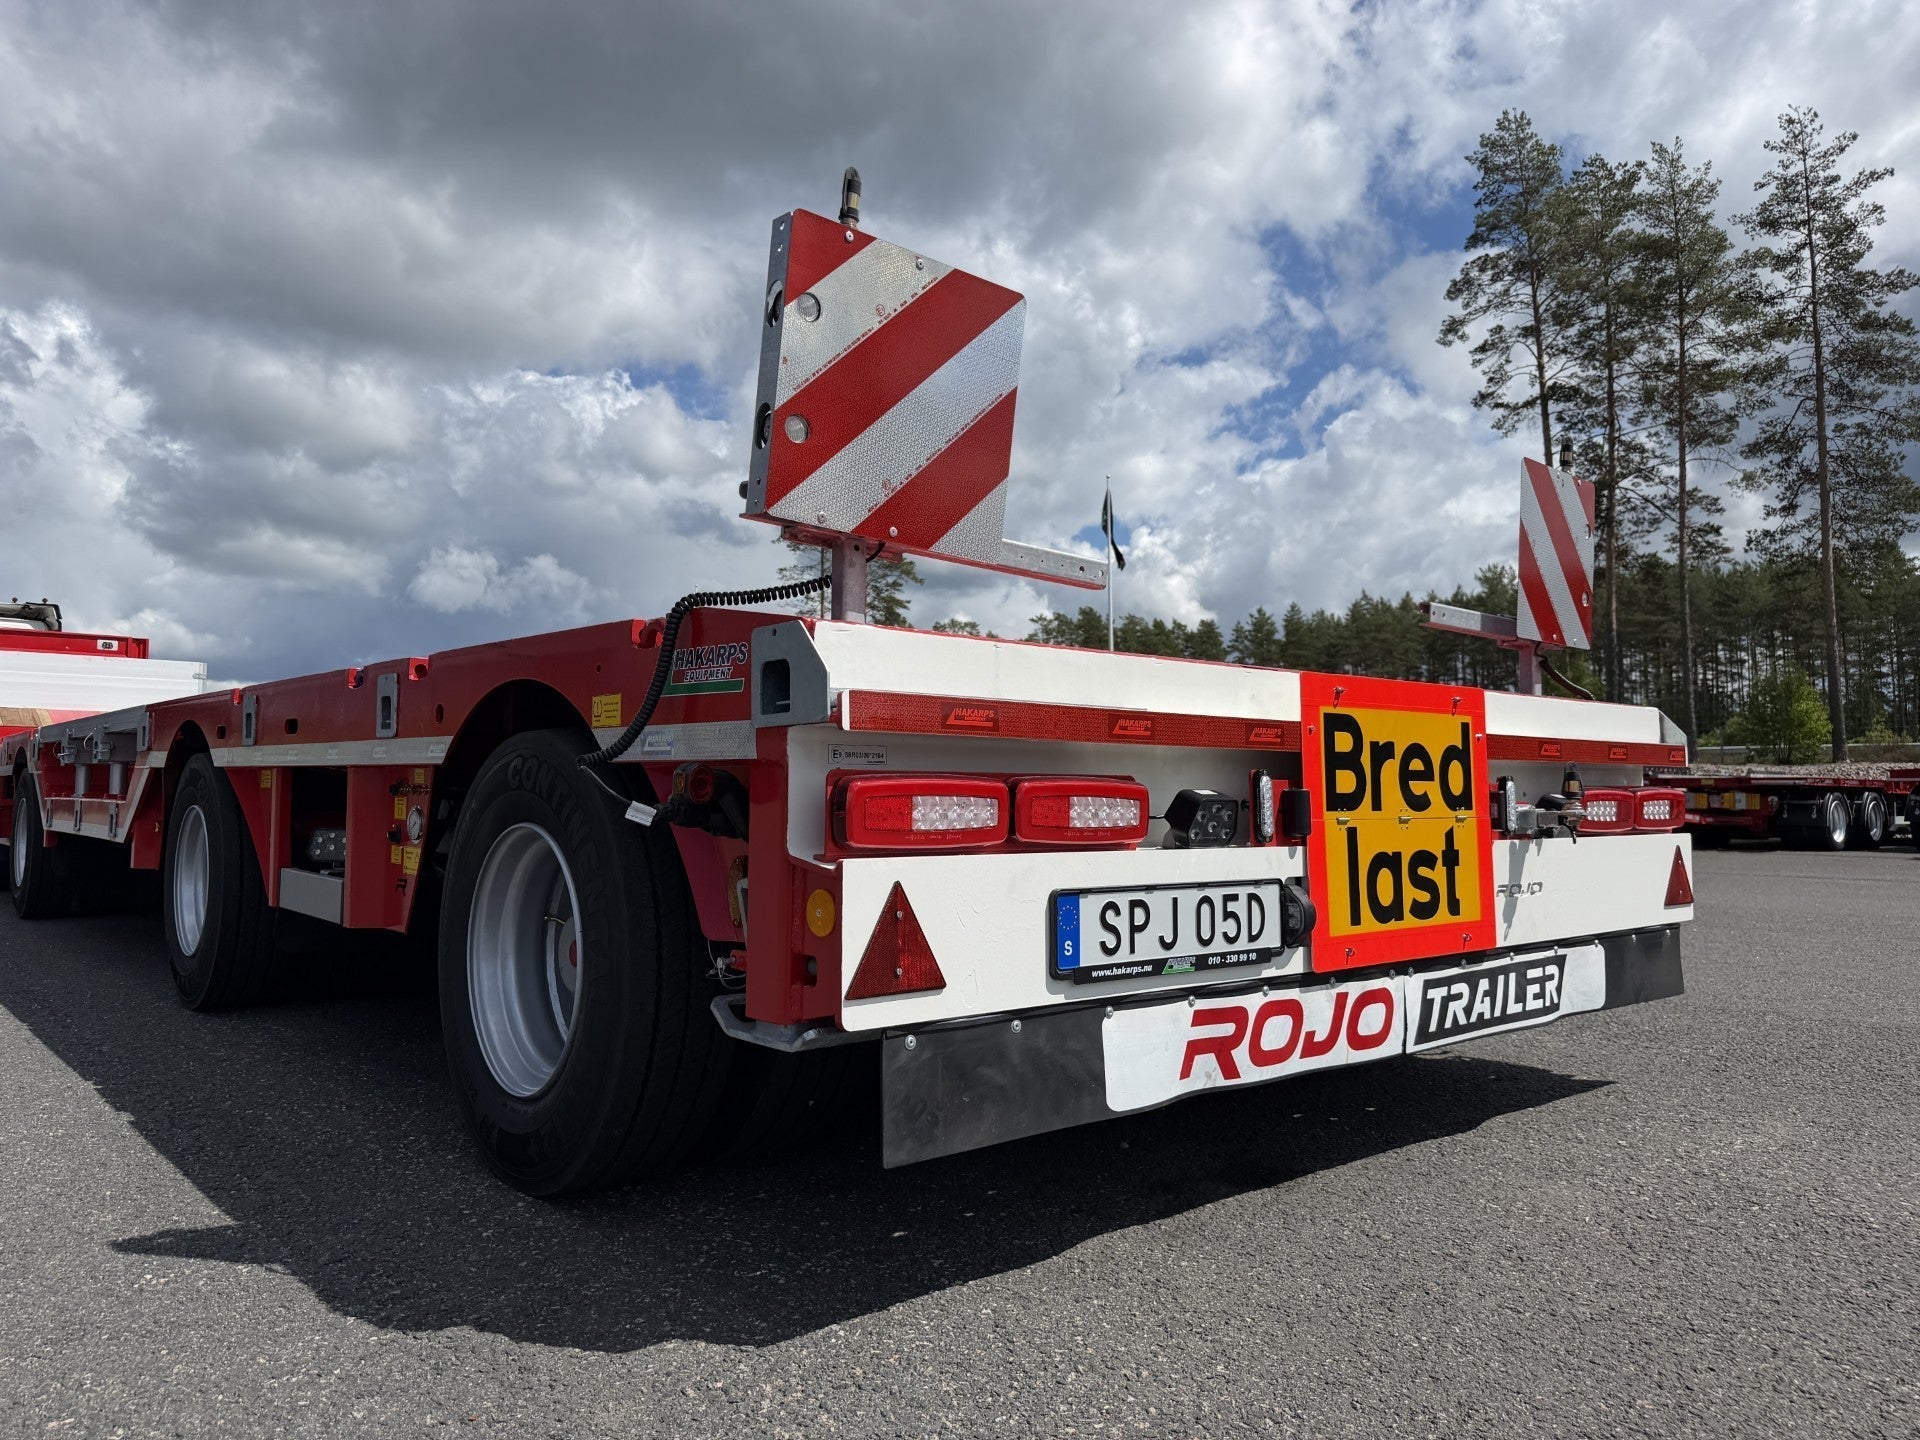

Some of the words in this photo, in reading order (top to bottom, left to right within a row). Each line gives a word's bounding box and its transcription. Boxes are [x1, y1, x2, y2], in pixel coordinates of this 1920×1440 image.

[674, 642, 749, 670] HAKARPS
[684, 667, 733, 682] EQUIPMENT
[954, 708, 995, 718] HAKARPS
[1323, 712, 1474, 813] Bred
[1346, 825, 1461, 927] last
[1099, 896, 1179, 956] SPJ
[1196, 892, 1266, 947] 05D
[1064, 940, 1072, 956] S
[1208, 956, 1221, 965] 010
[1225, 954, 1238, 963] 330
[1239, 953, 1248, 962] 99
[1248, 952, 1257, 960] 10
[1091, 964, 1153, 978] www.hakarps.nu
[1426, 964, 1560, 1033] TRAILER
[1179, 987, 1394, 1081] ROJO
